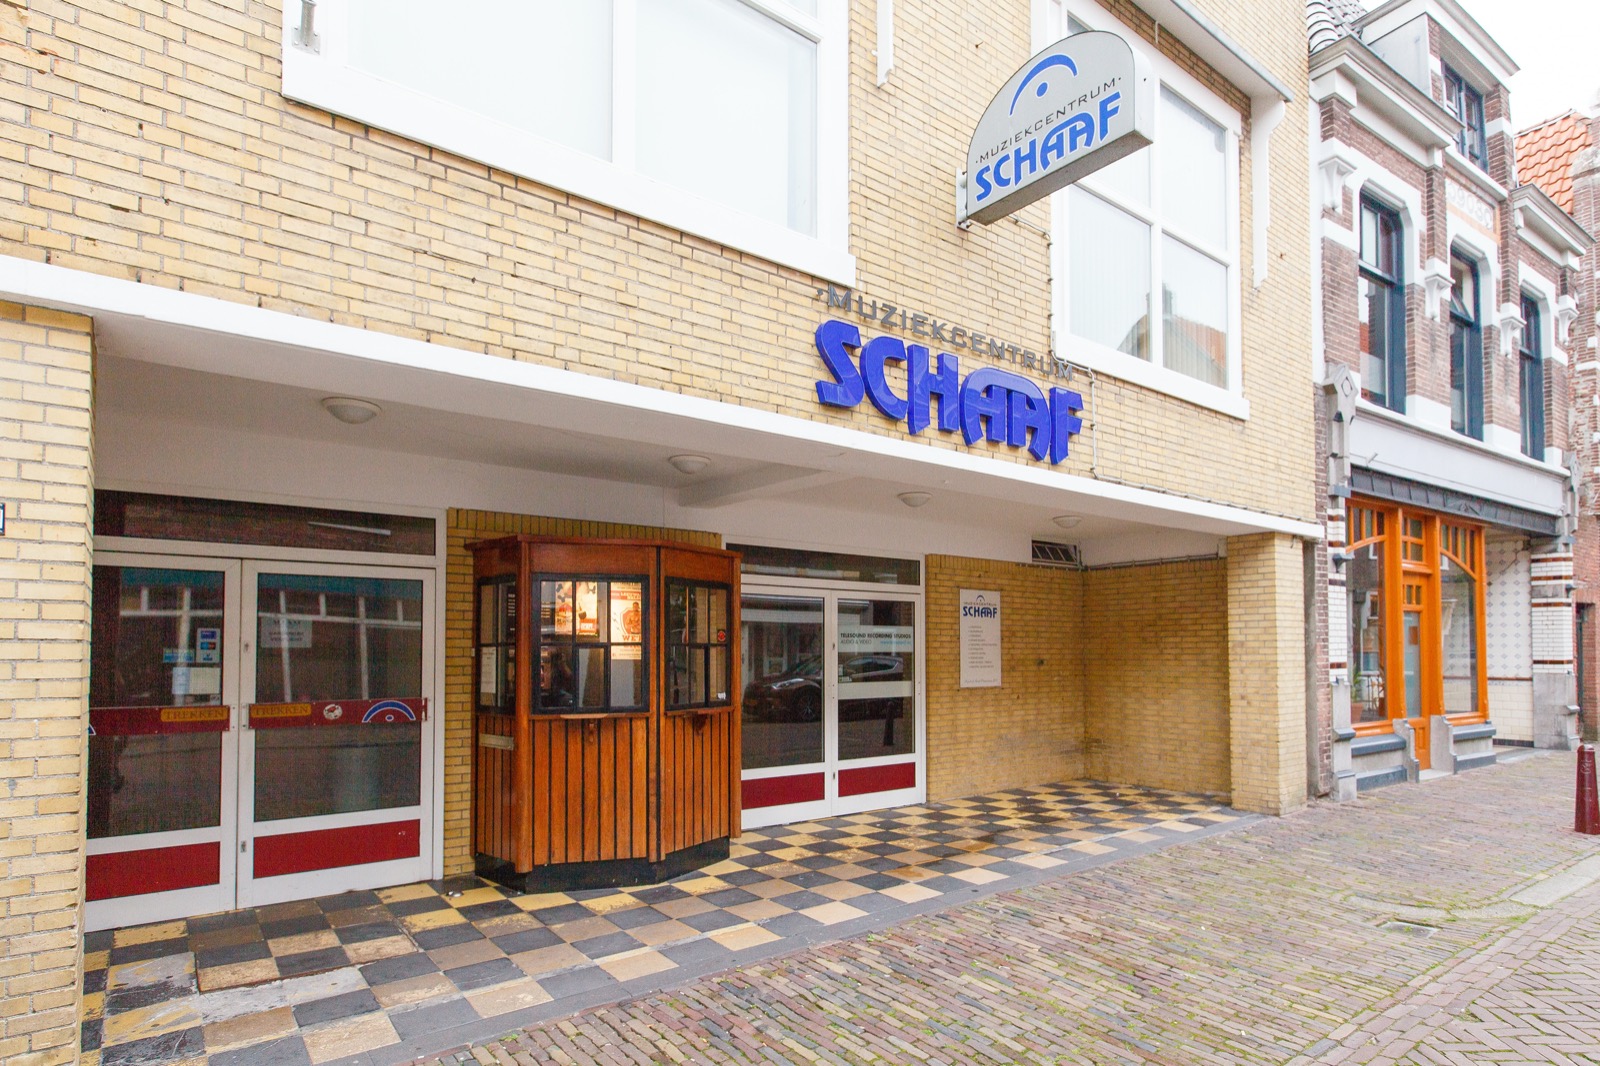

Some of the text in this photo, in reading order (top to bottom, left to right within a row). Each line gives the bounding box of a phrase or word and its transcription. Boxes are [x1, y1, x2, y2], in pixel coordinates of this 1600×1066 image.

[975, 91, 1122, 202] SCHAAF
[815, 319, 1084, 466] SCHAAF
[962, 605, 998, 619] SCHAAF
[166, 710, 224, 720] TREKKEN
[255, 705, 308, 716] TREKKEN
